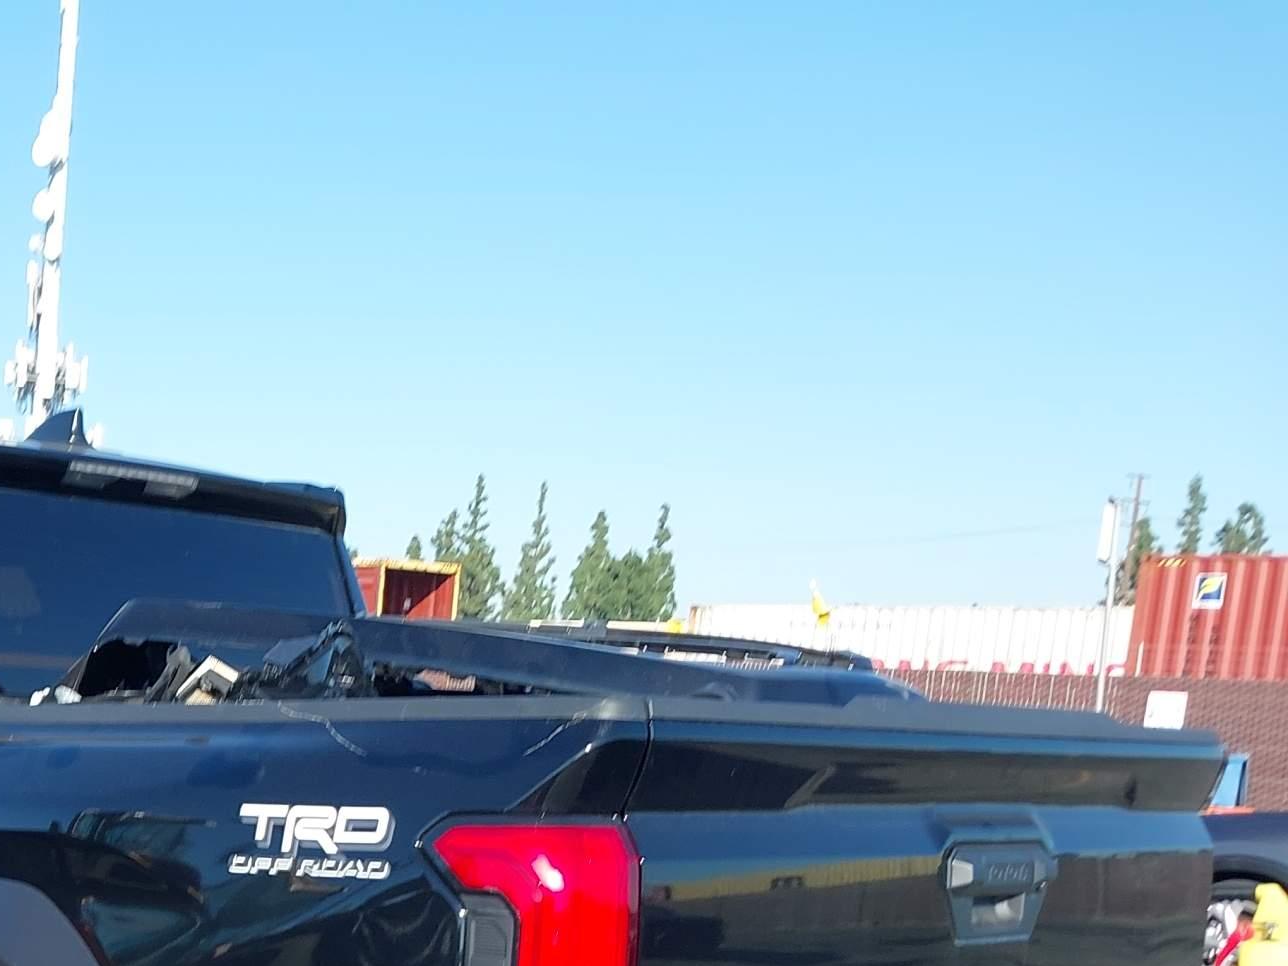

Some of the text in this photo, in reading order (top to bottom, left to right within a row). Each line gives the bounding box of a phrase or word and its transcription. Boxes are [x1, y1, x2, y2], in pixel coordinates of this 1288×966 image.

[239, 803, 396, 855] TRD
[228, 854, 391, 880] OFF ROAD
